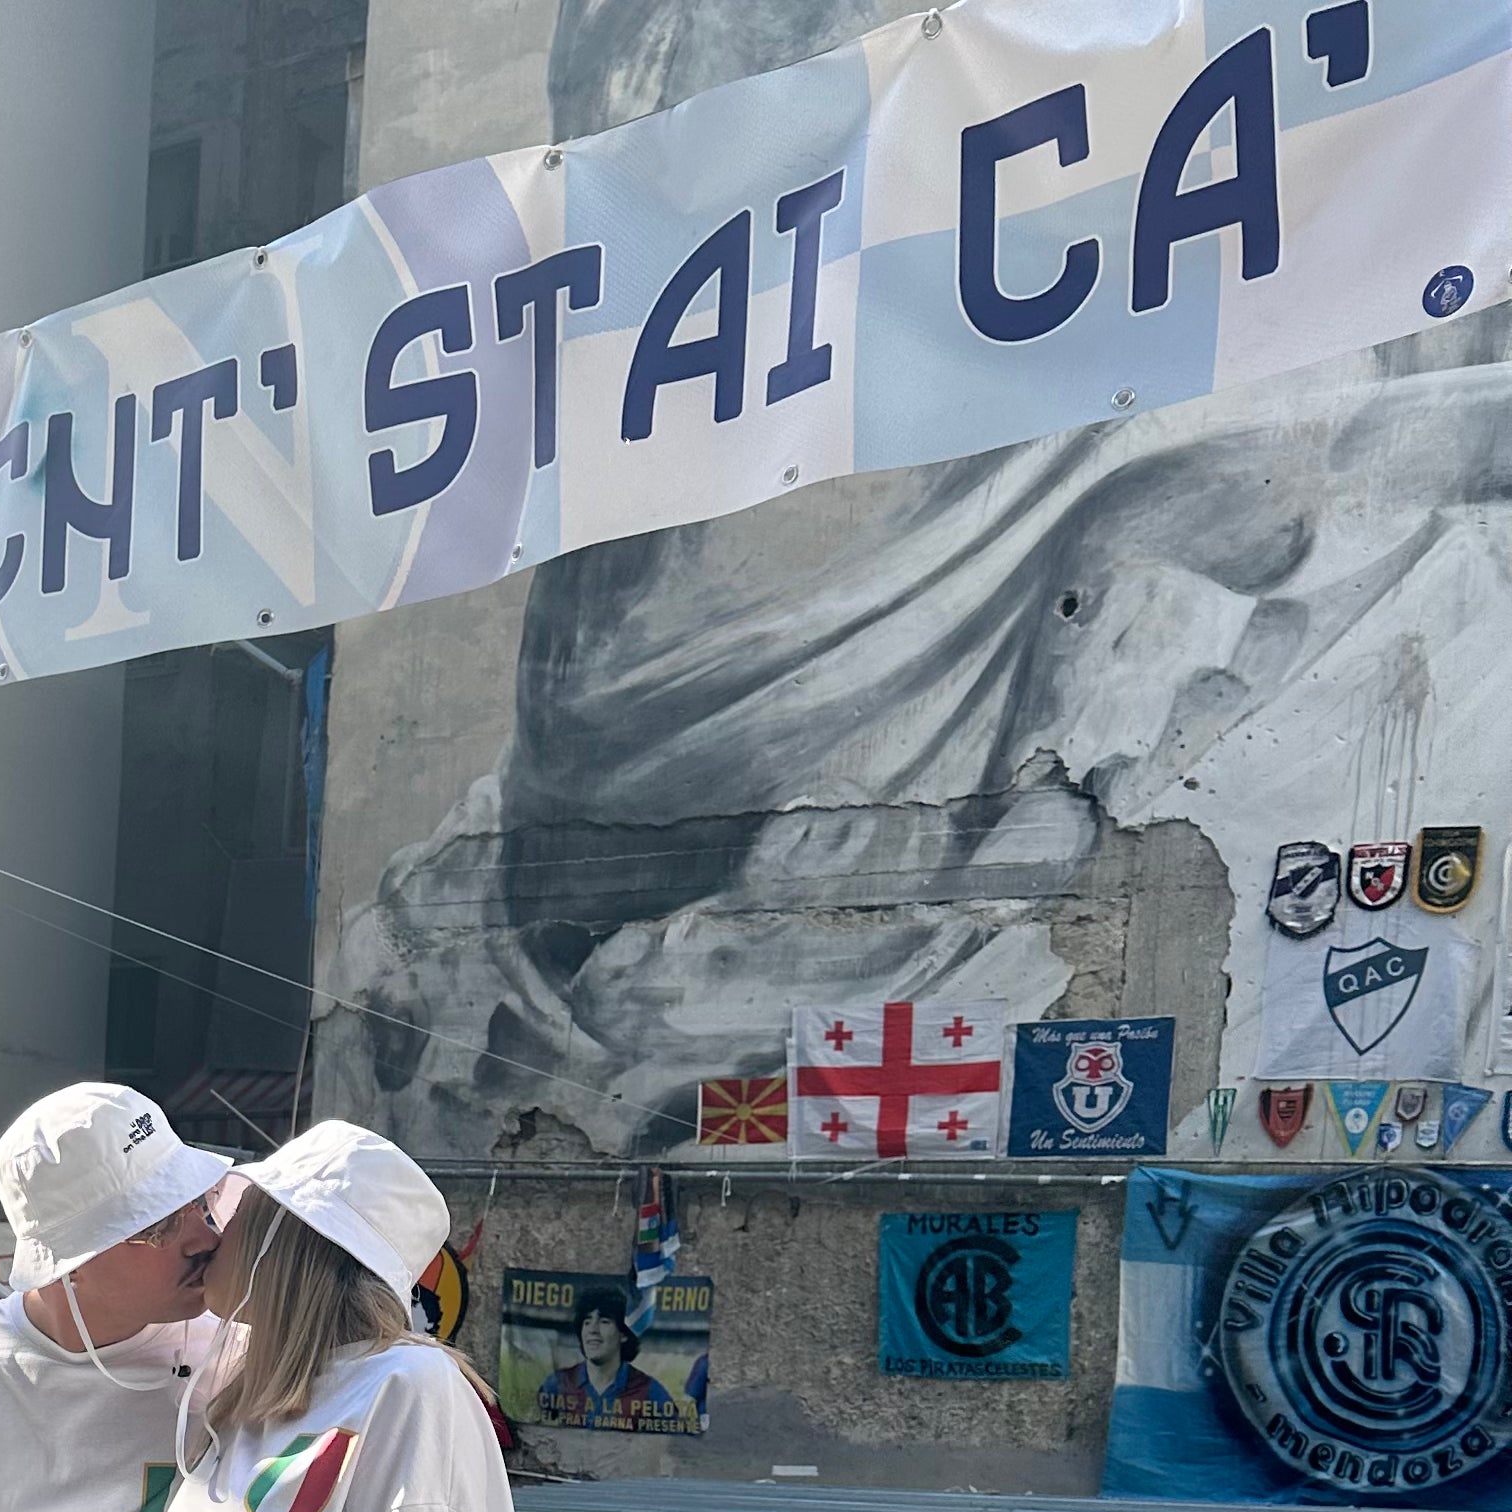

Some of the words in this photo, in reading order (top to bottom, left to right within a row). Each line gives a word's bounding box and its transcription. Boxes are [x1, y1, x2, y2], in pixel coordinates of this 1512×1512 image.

[365, 166, 846, 517] STAI
[958, 0, 1371, 342] CA'
[1338, 956, 1405, 994] QAC
[1065, 1033, 1086, 1046] que
[1072, 1086, 1113, 1118] U
[907, 1213, 1041, 1237] MURALES
[511, 1279, 574, 1308] DIEGO
[1223, 1226, 1305, 1332] Villa
[602, 1398, 623, 1416] LA
[630, 1399, 698, 1418] PELOTA
